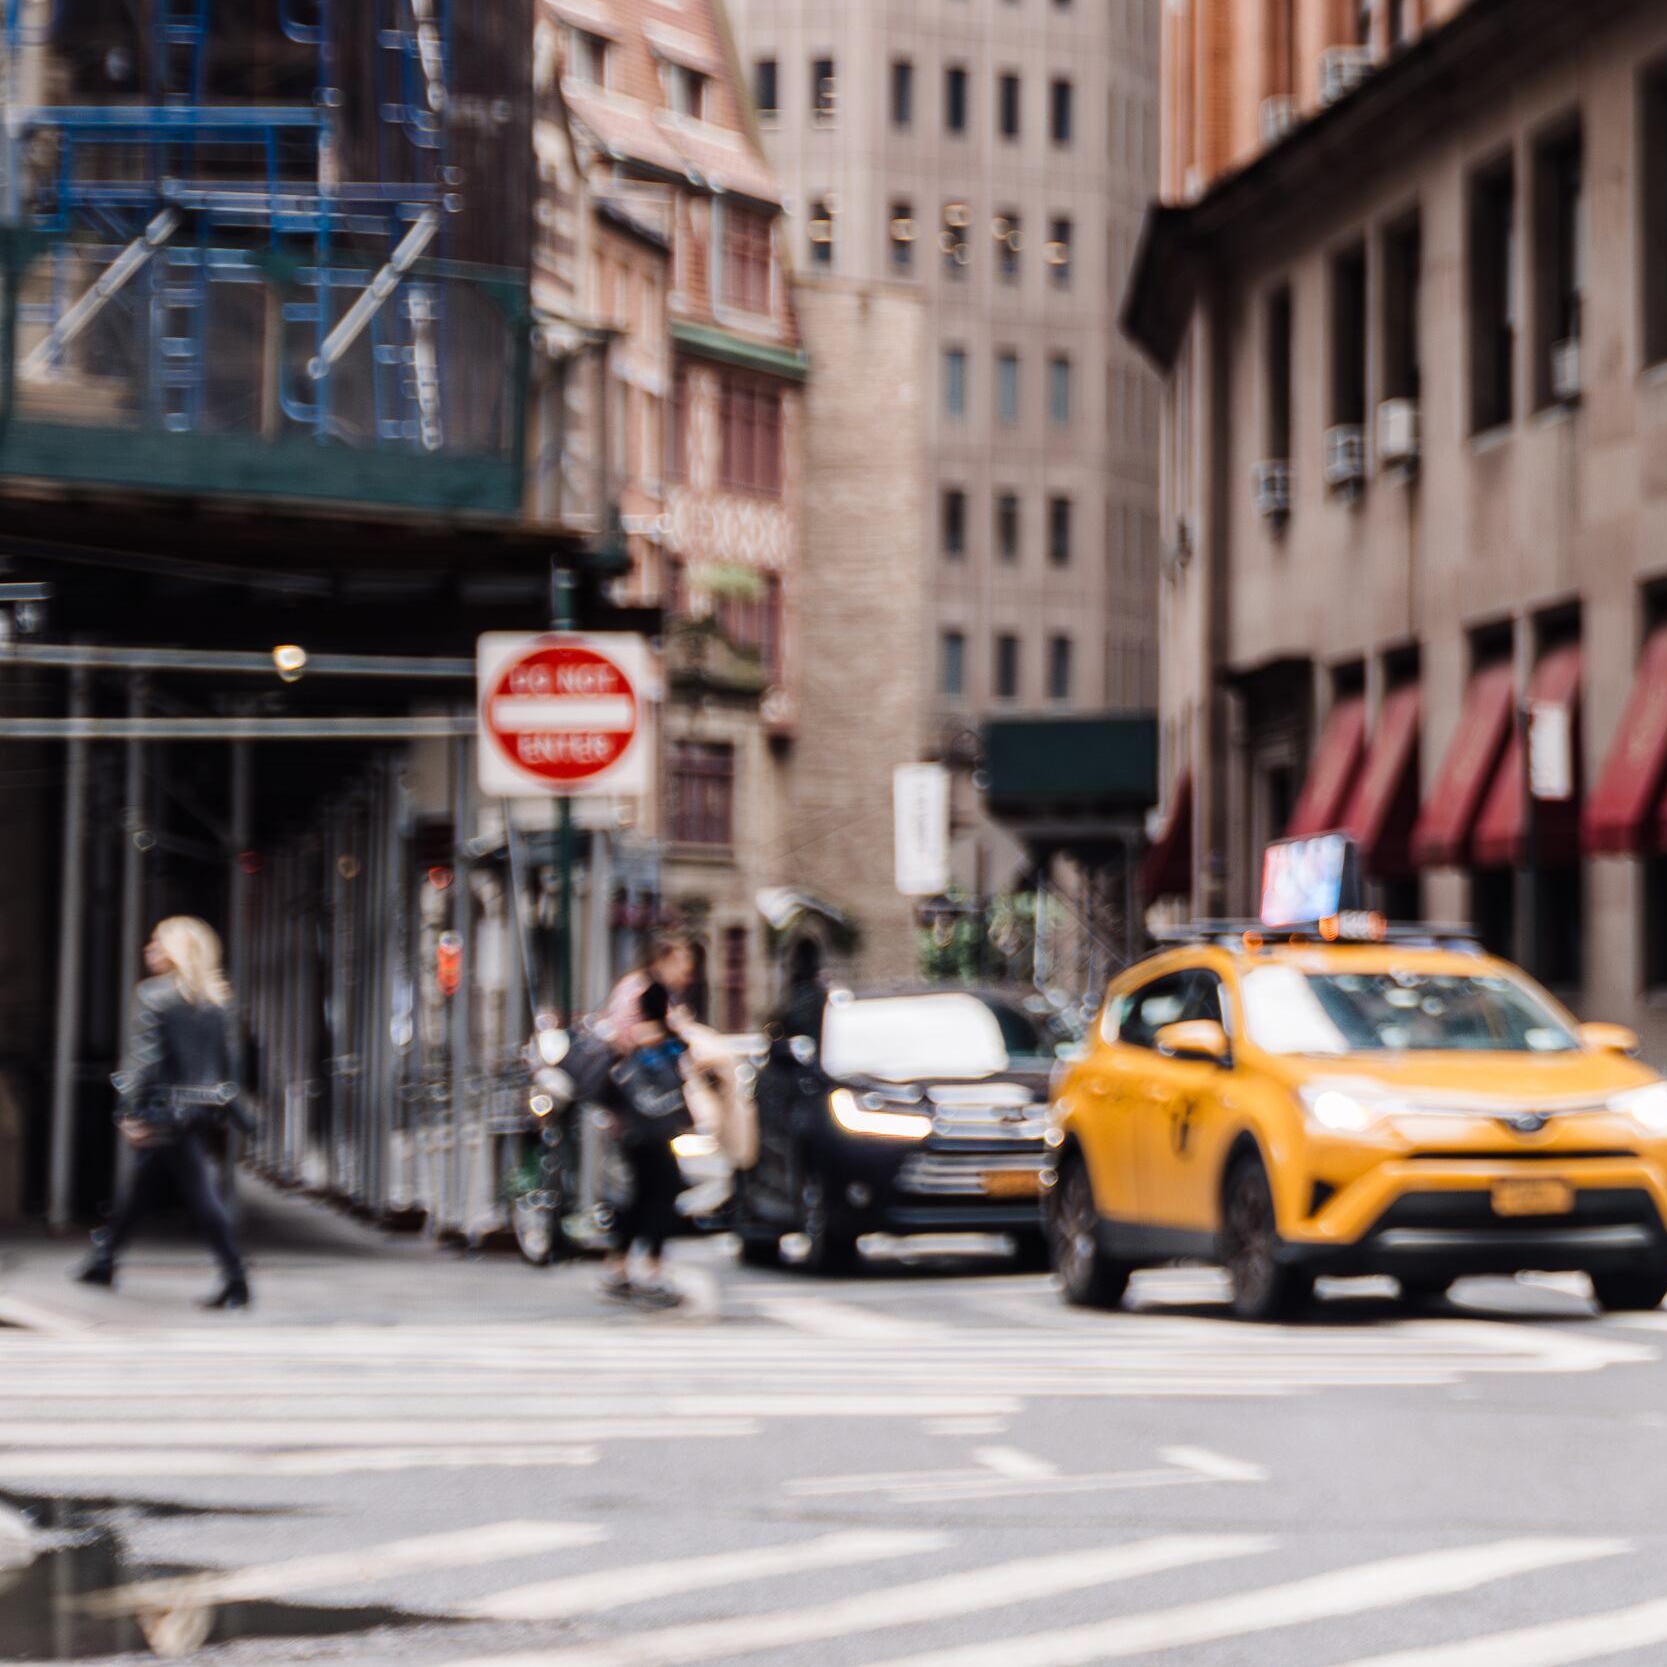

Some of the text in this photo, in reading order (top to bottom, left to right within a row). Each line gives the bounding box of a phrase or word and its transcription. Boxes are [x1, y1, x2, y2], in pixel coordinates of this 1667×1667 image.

[509, 663, 616, 695] DO NOT
[518, 733, 611, 765] ENTER
